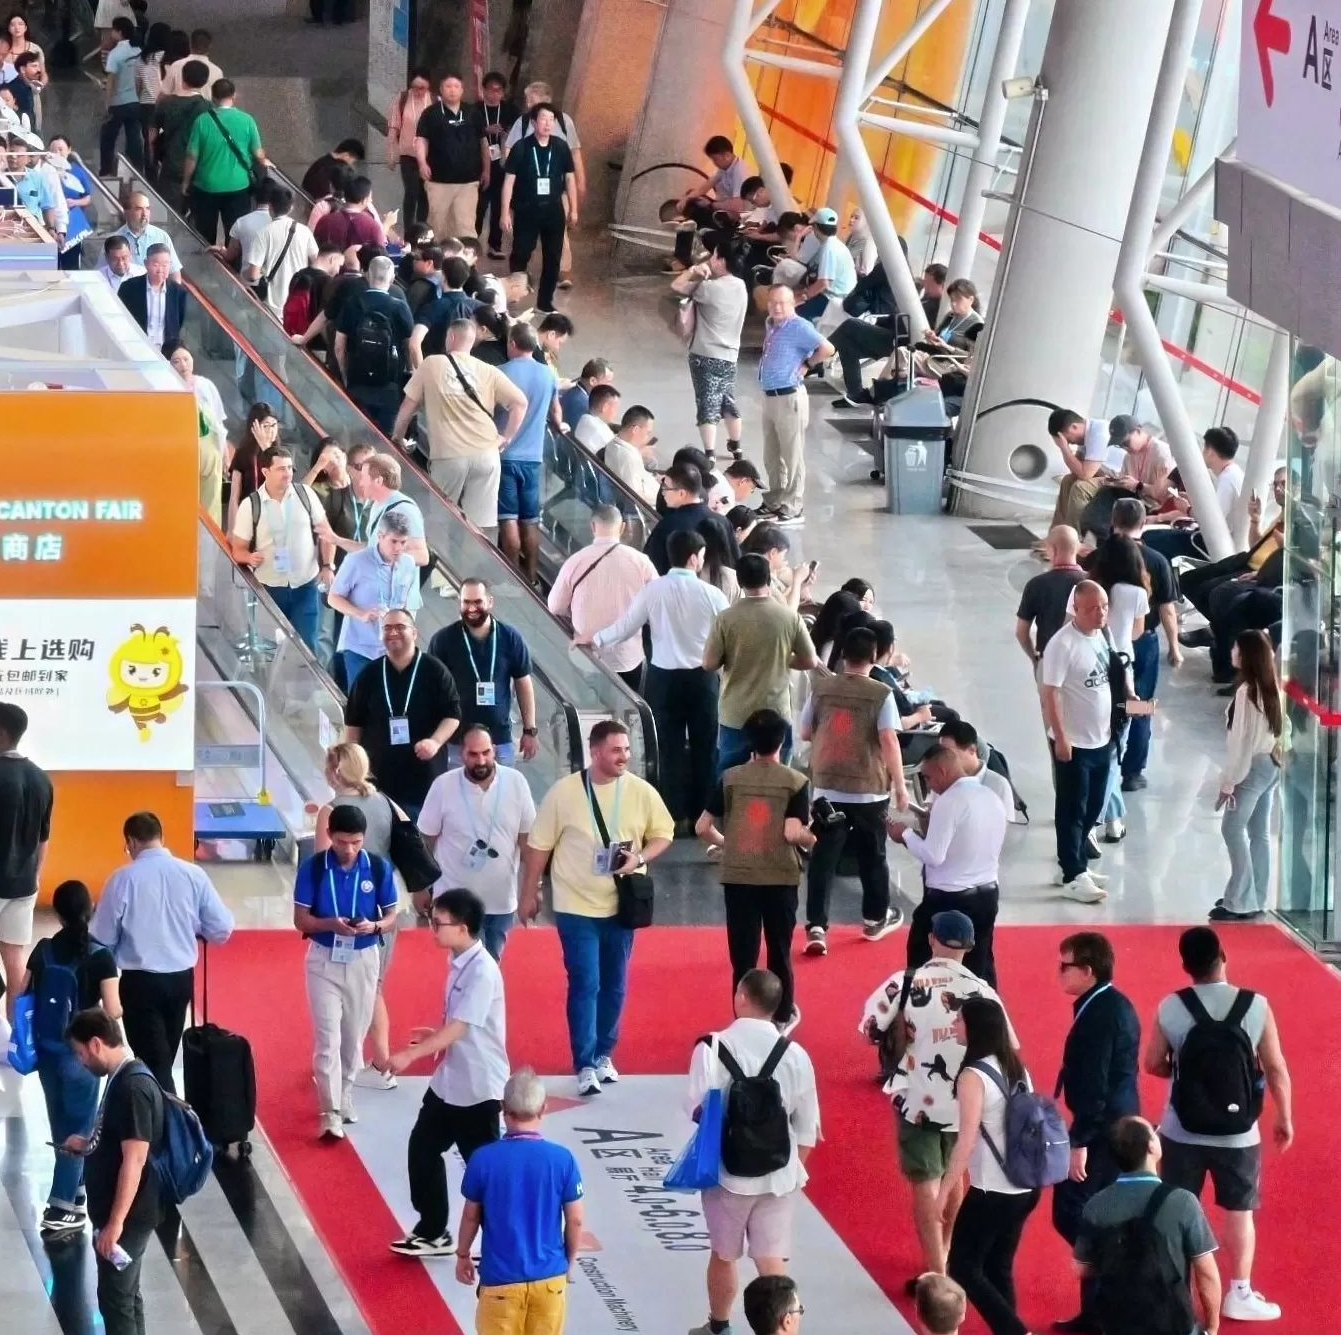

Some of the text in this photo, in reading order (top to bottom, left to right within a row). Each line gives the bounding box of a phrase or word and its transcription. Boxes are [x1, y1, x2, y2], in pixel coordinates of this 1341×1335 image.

[1323, 20, 1340, 47] Area
[1302, 14, 1334, 91] A 区
[95, 500, 143, 520] FAIR
[572, 1127, 664, 1144] A
